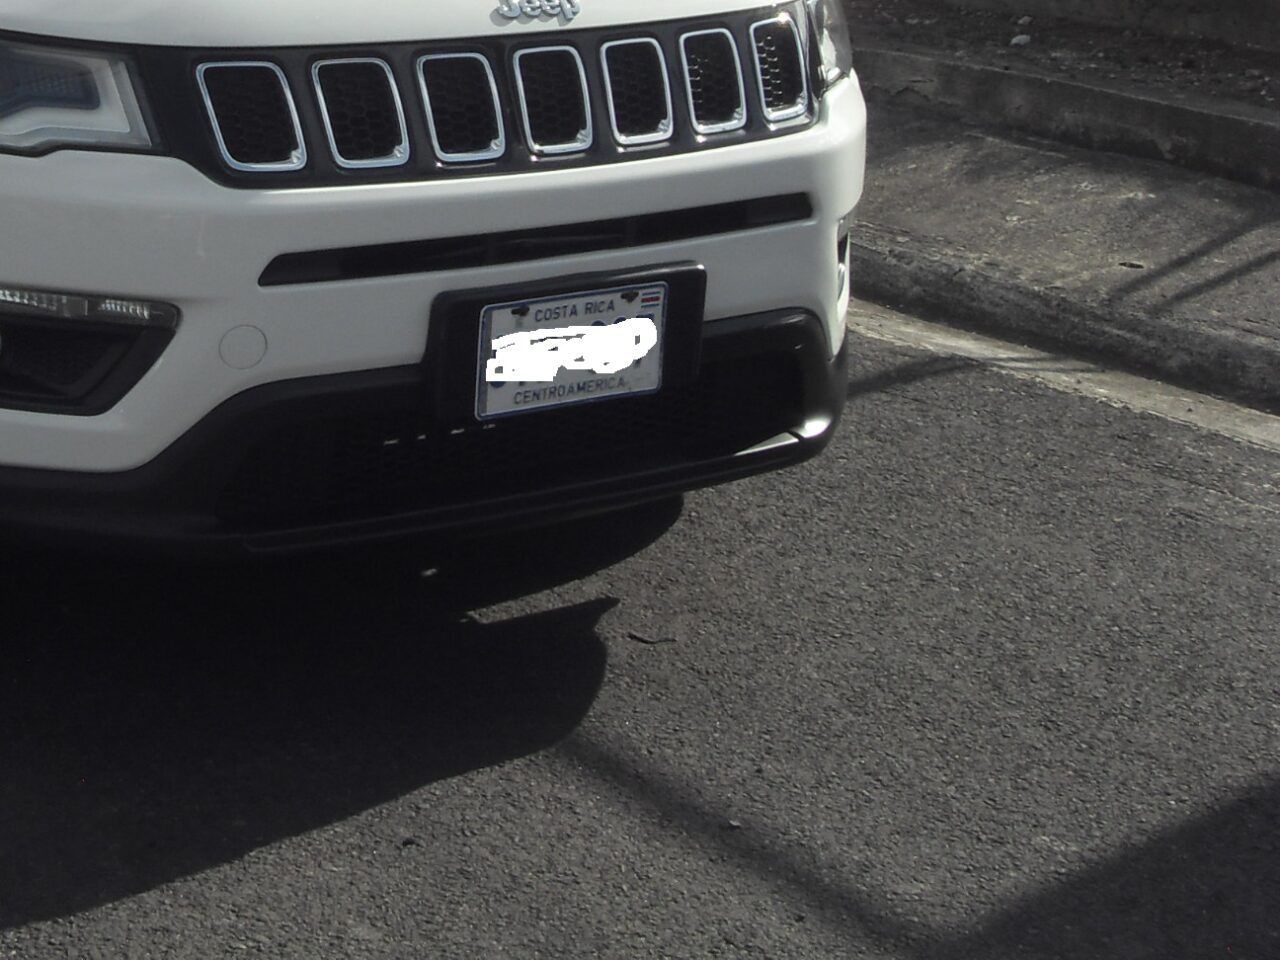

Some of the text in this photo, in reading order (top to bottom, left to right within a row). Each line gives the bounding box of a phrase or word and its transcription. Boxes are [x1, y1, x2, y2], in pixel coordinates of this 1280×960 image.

[535, 299, 615, 322] COSTA RICA
[513, 376, 626, 405] CENTROAMERICA
